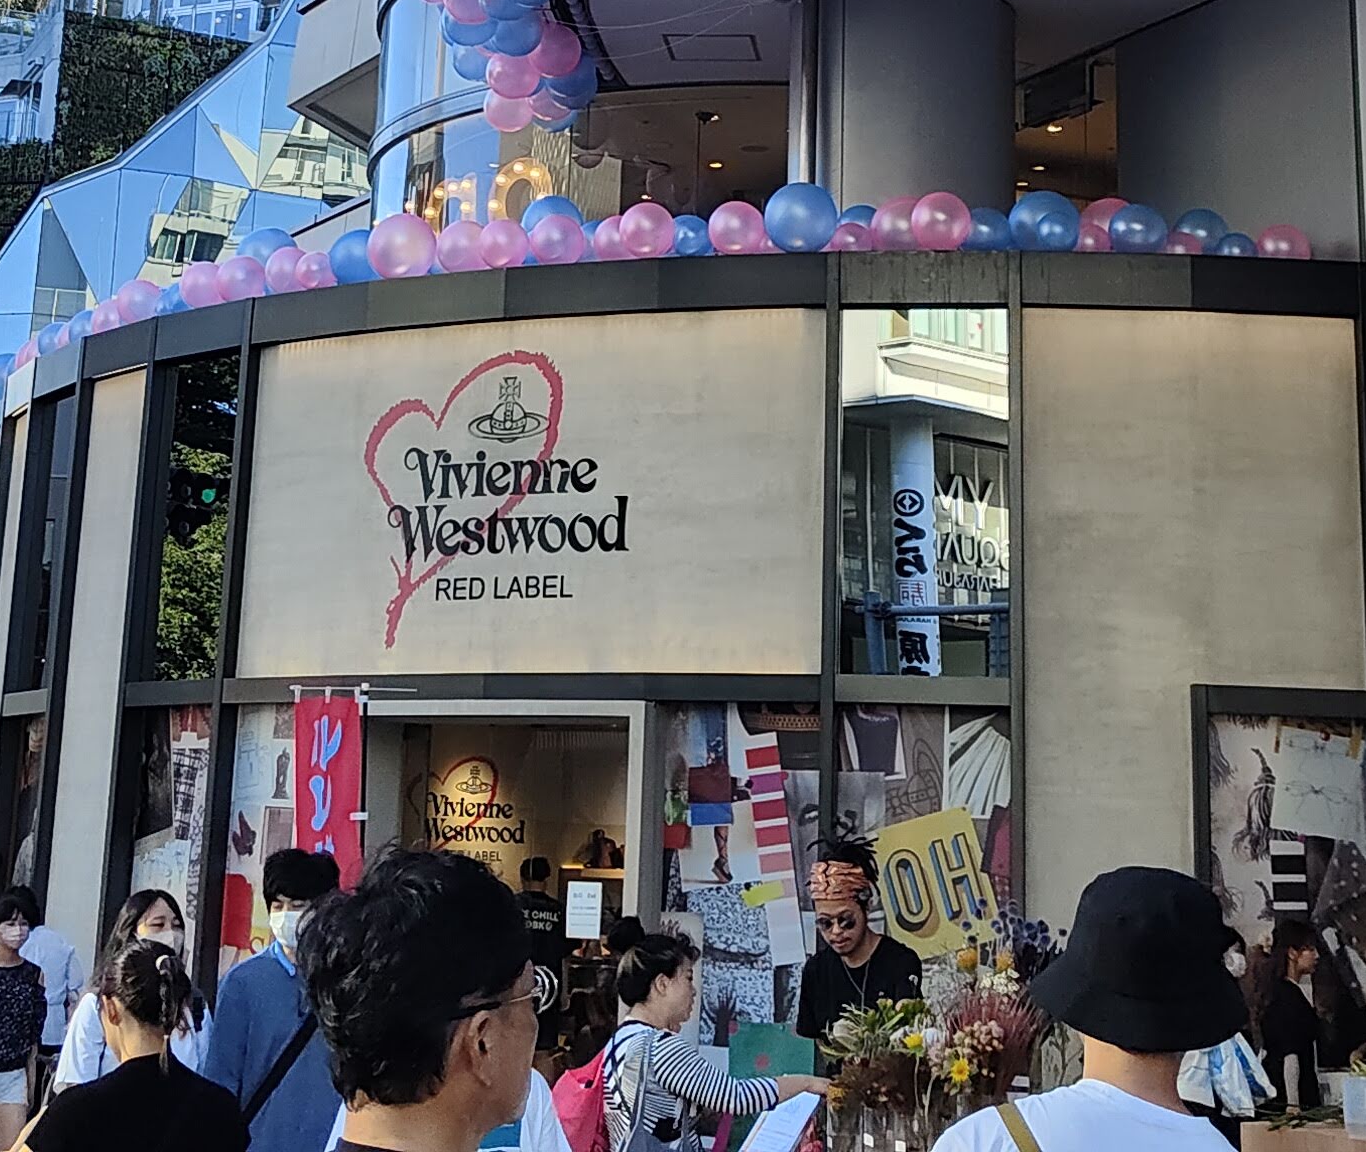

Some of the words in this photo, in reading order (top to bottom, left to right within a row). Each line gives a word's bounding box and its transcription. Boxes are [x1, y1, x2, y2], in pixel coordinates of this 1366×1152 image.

[404, 447, 598, 503] Vivienne
[388, 495, 630, 563] Westwood
[435, 577, 485, 601] RED
[493, 575, 573, 600] LABEL
[427, 791, 513, 819] Vivienne
[425, 817, 526, 844] Westwood
[884, 832, 985, 933] OH
